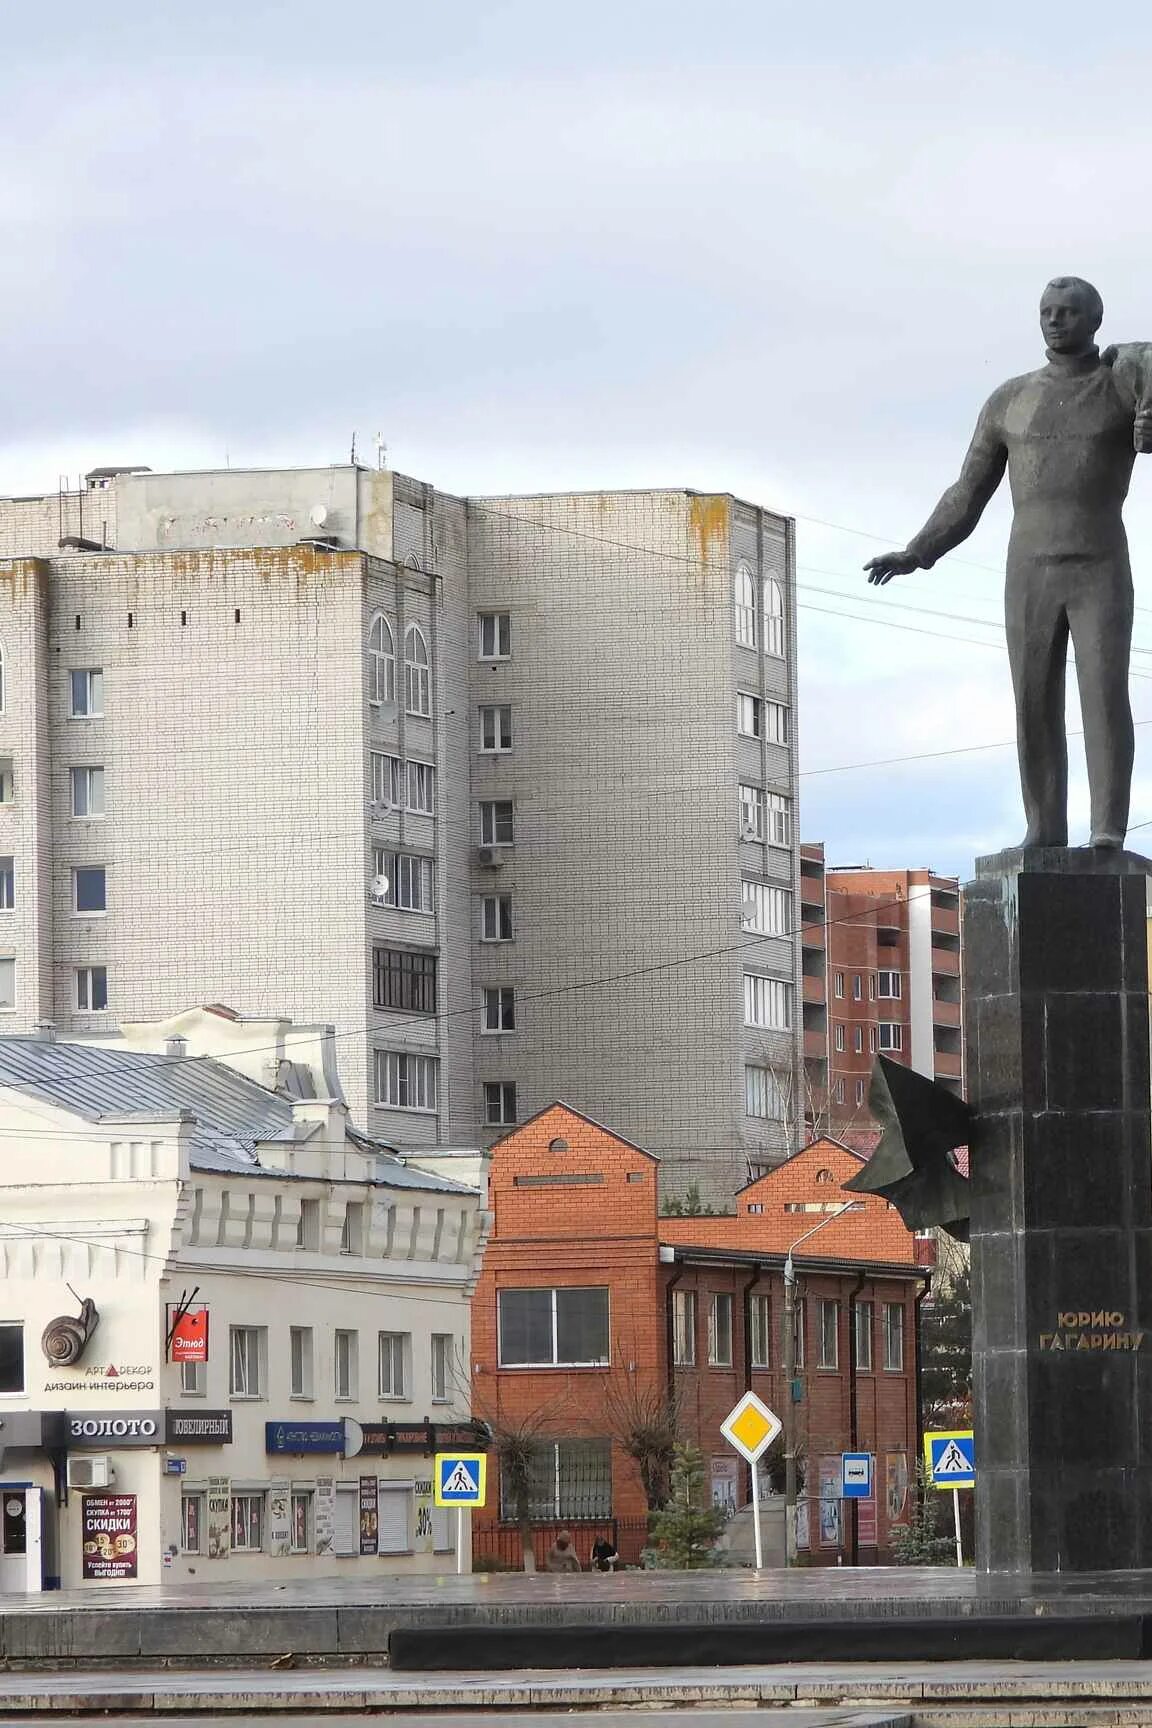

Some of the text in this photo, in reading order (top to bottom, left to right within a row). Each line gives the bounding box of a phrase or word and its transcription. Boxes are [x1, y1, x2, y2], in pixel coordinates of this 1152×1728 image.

[1058, 1309, 1124, 1329] ЮРИЮ
[175, 1337, 204, 1349] Этюд
[1040, 1332, 1144, 1352] ГАГАРИНУ
[89, 1380, 154, 1392] интерьера
[71, 1419, 156, 1436] ЗОЛОТО
[176, 1414, 229, 1435] ЮВЕЛИРНЫЙ
[87, 1519, 130, 1531] СКИДКИ
